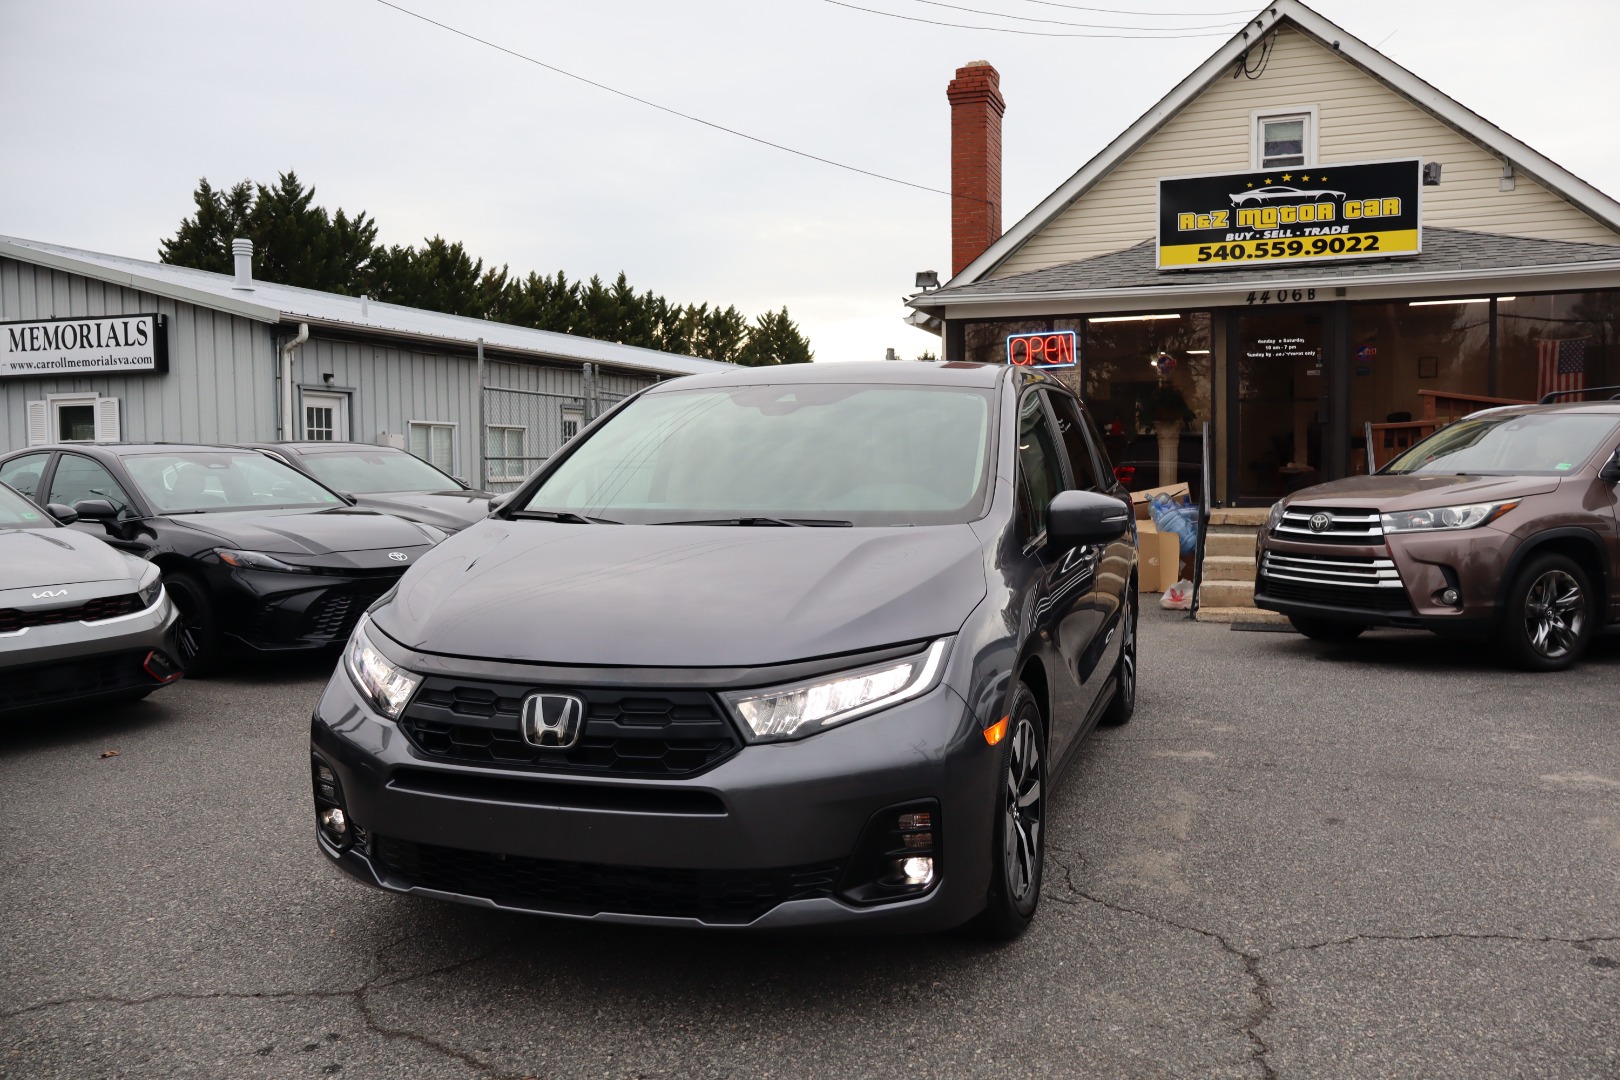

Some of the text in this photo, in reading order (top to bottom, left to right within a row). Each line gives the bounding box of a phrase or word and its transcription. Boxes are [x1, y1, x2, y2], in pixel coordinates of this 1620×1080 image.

[1225, 225, 1350, 241] BUY SELL TRADE
[1198, 235, 1379, 262] 540.559.9022
[9, 320, 148, 352] MEMORIALS
[10, 355, 152, 370] www.carrollmemorialsva.com
[1010, 334, 1073, 366] OPEN
